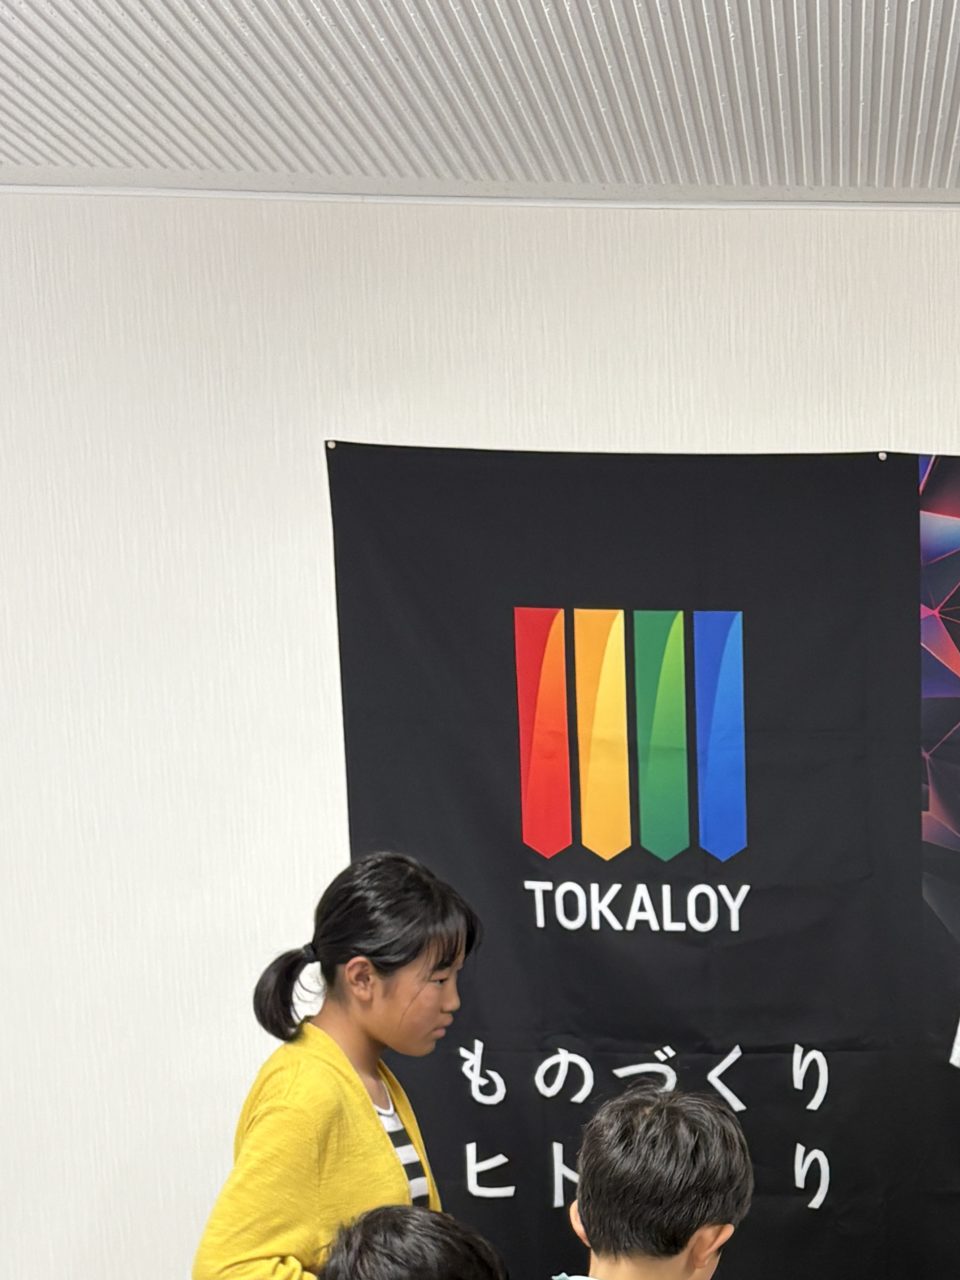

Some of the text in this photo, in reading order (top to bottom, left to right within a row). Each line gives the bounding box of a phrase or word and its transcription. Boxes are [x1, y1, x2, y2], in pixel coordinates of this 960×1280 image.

[523, 880, 751, 932] TOKALOY
[459, 1039, 829, 1112] ものづくり
